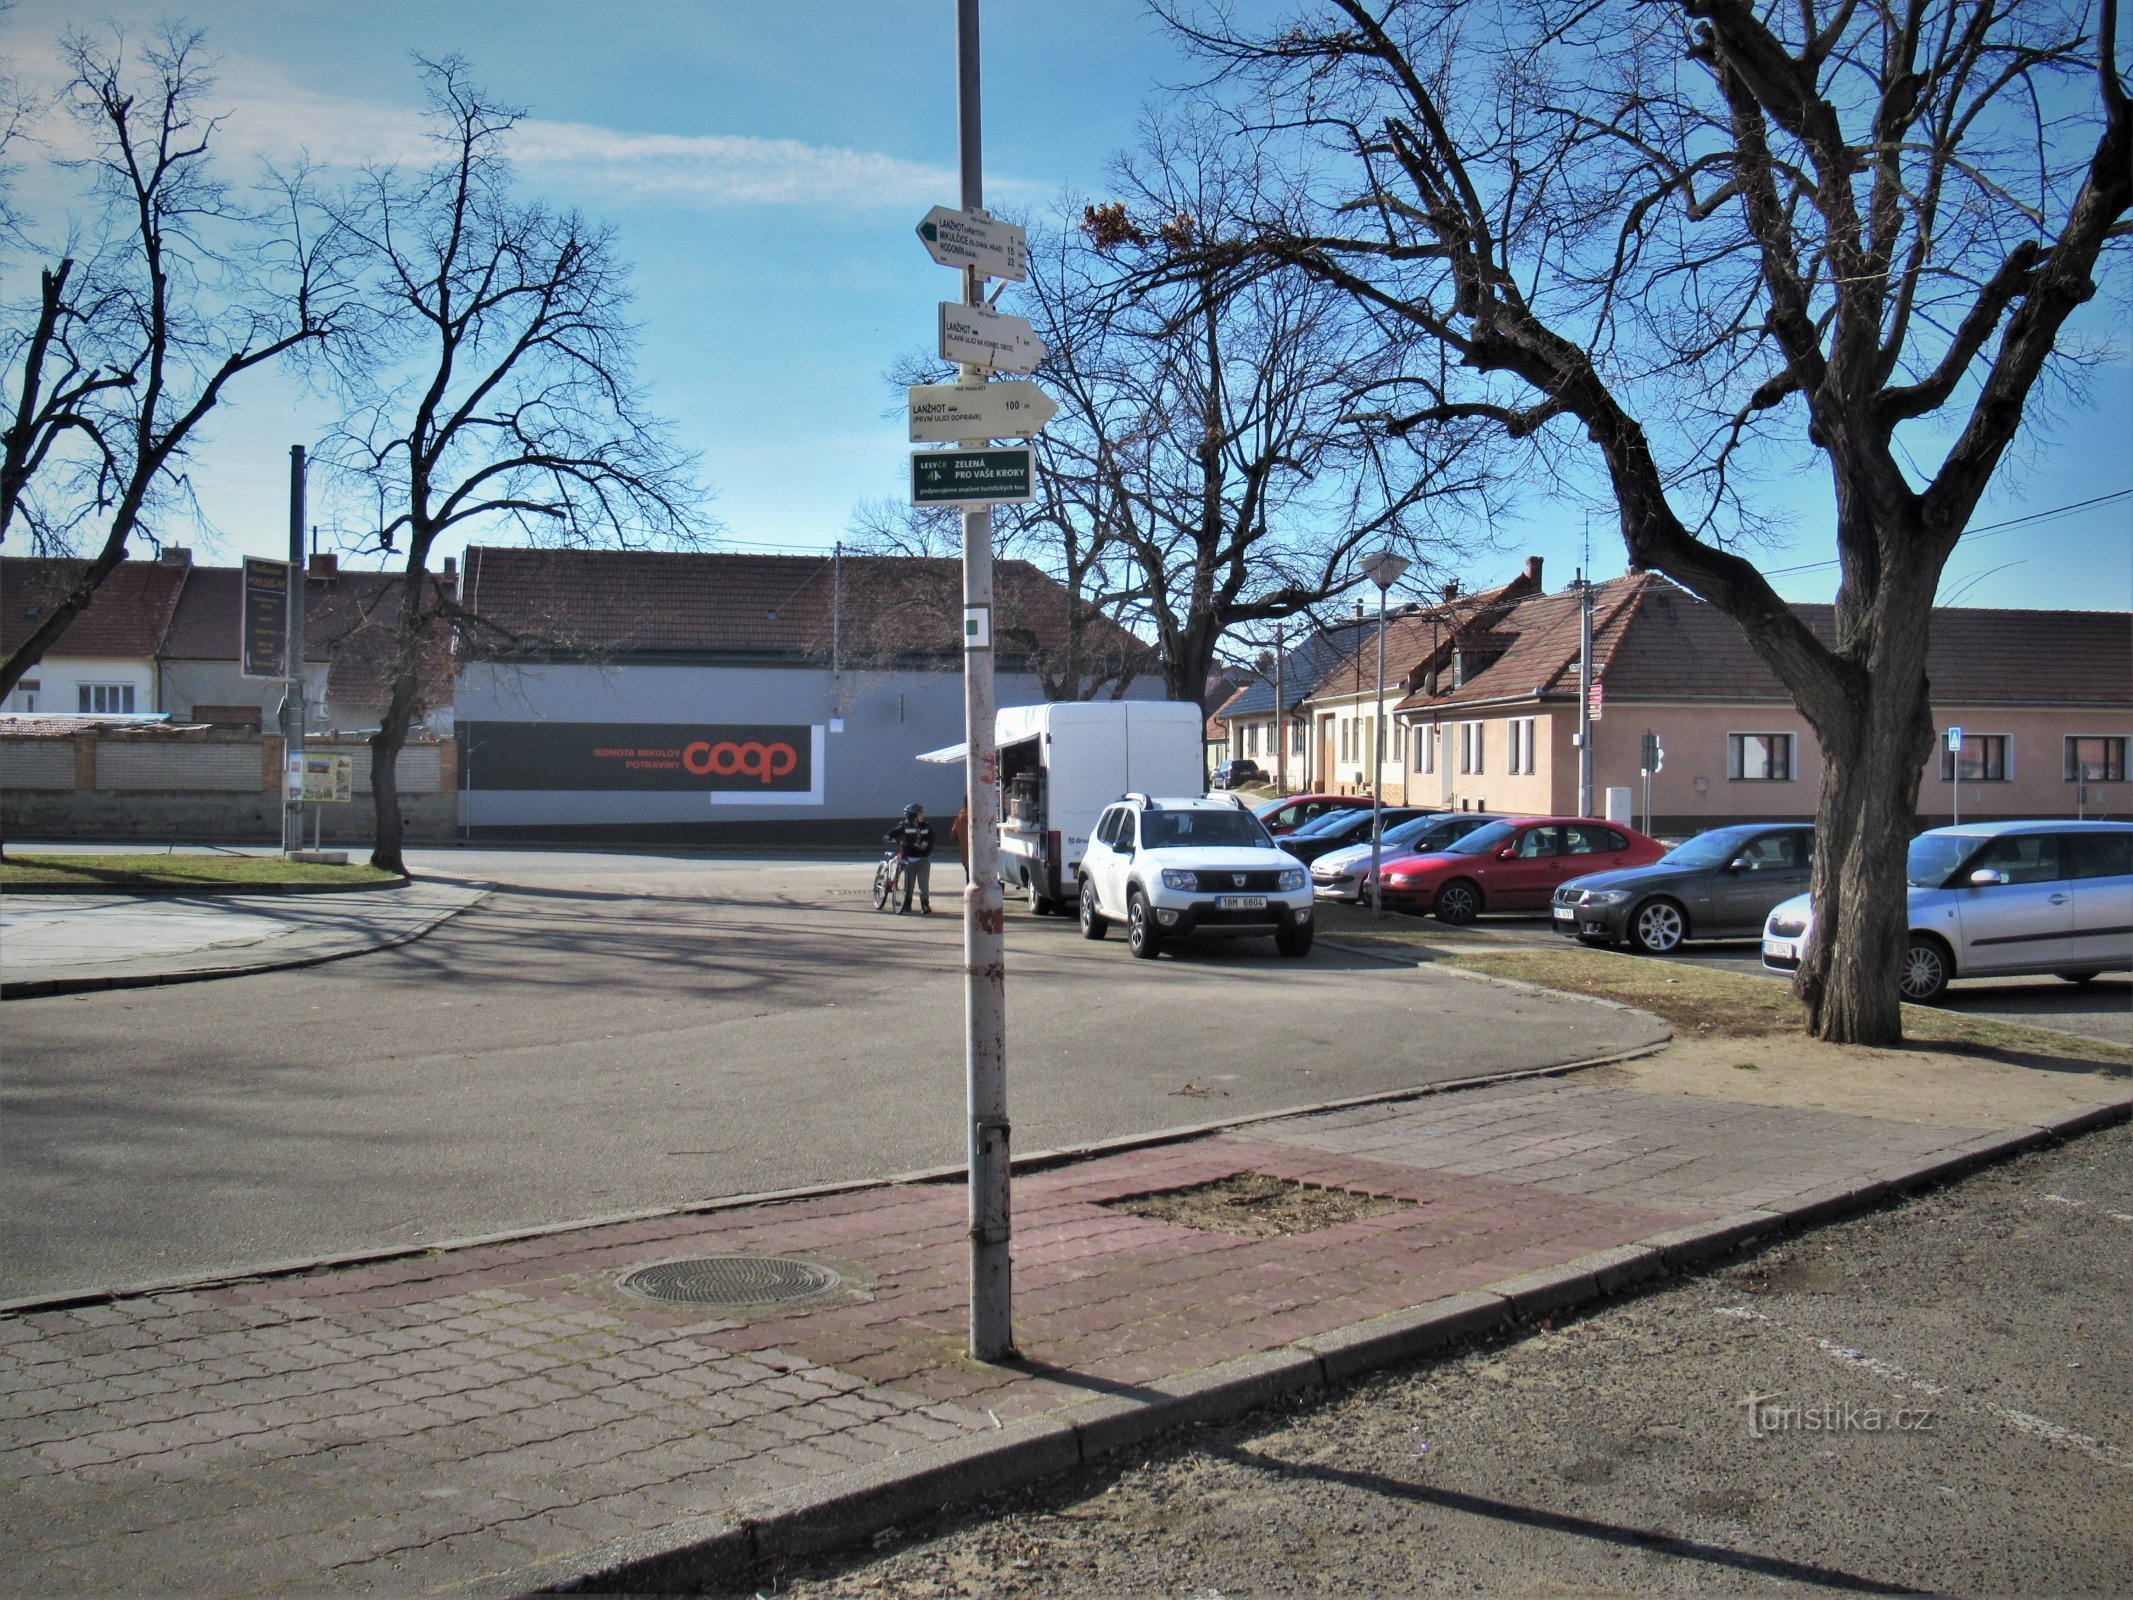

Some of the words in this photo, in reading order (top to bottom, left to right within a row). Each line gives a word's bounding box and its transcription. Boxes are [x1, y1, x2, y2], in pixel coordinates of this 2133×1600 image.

[940, 219, 964, 232] LANŽHOT
[940, 230, 969, 246] MIKULČICE
[1007, 246, 1014, 256] 15
[940, 241, 964, 255] HODONÍN
[1007, 257, 1014, 267] 22
[946, 321, 971, 334] LANŽHOT
[912, 402, 946, 414] LANŽHOT
[1005, 400, 1020, 410] 100
[951, 413, 982, 421] DOPRAVA)
[954, 457, 986, 469] ZELENÁ
[955, 471, 972, 479] PRO
[972, 467, 994, 478] VAŠE
[996, 468, 1025, 477] KROKY
[920, 487, 957, 495] podporujeme
[593, 748, 636, 758] JEDNOTA
[637, 748, 681, 758] MIKULOV
[625, 760, 681, 769] POTRAVINY
[1243, 898, 1263, 907] 6804
